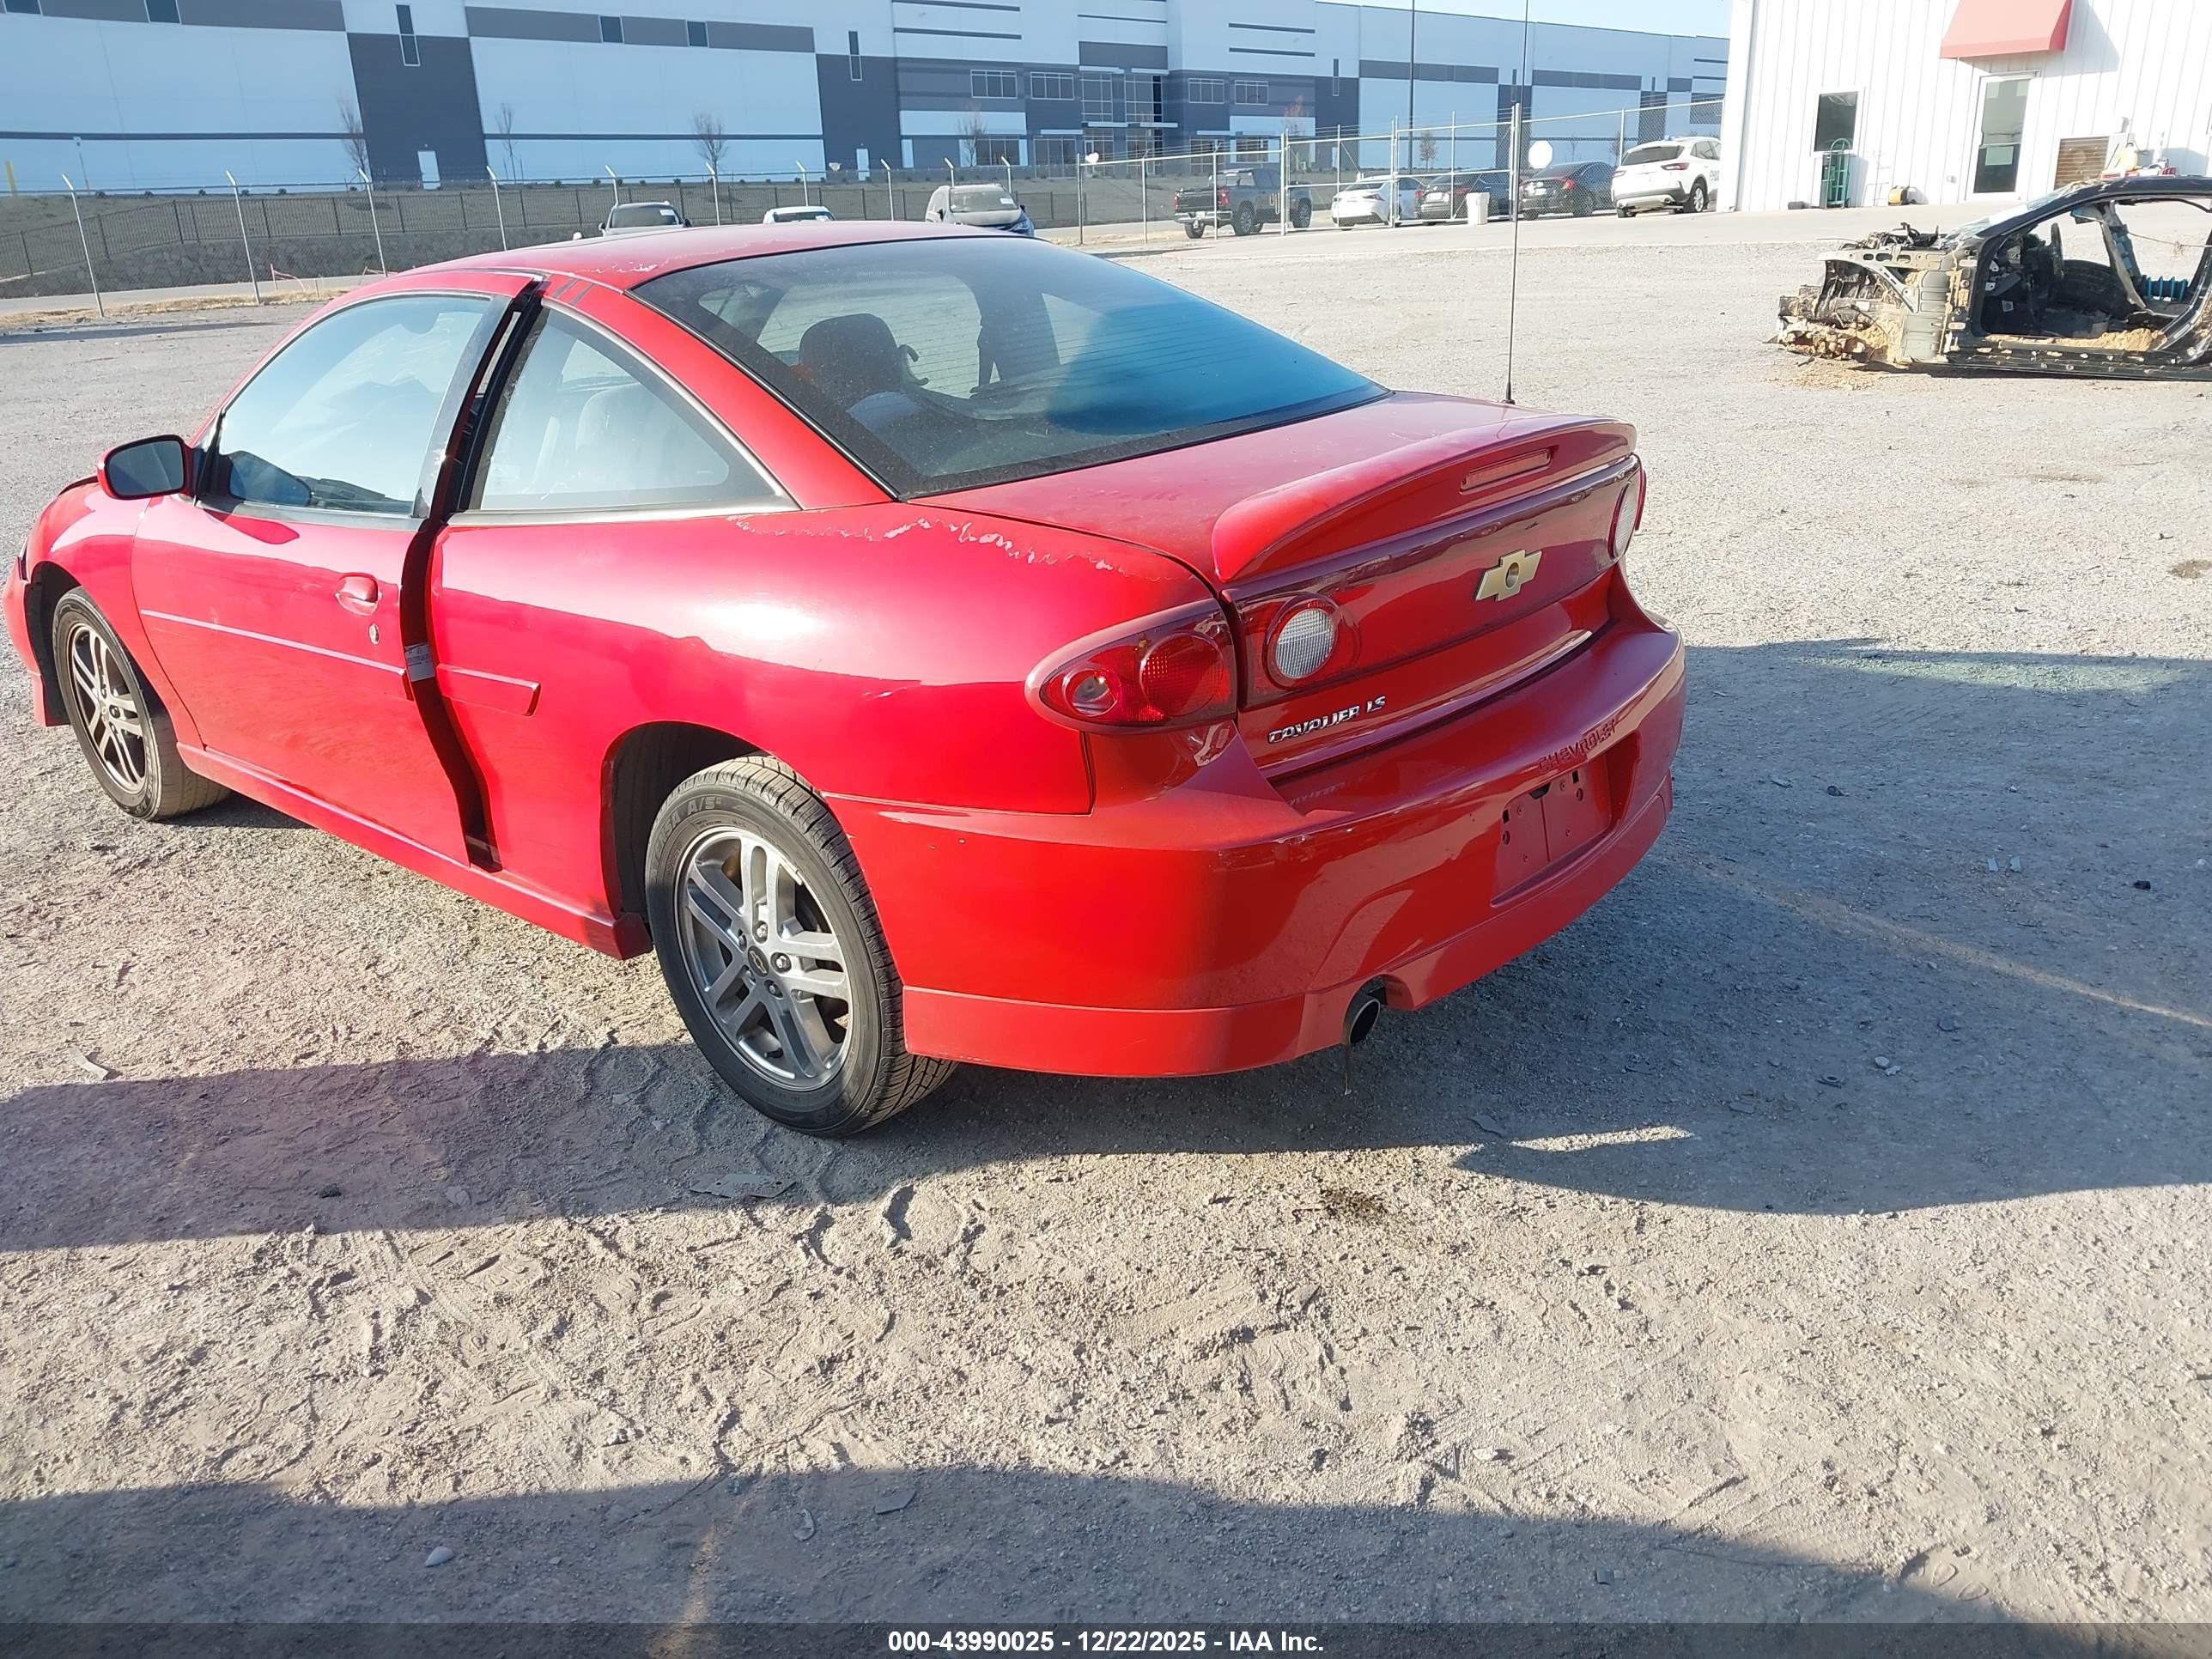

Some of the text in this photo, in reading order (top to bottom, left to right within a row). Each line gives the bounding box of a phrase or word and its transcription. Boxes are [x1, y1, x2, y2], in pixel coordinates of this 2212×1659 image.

[1268, 696, 1386, 743] CAVALIER LS
[1538, 720, 1615, 772] CHEVROLET
